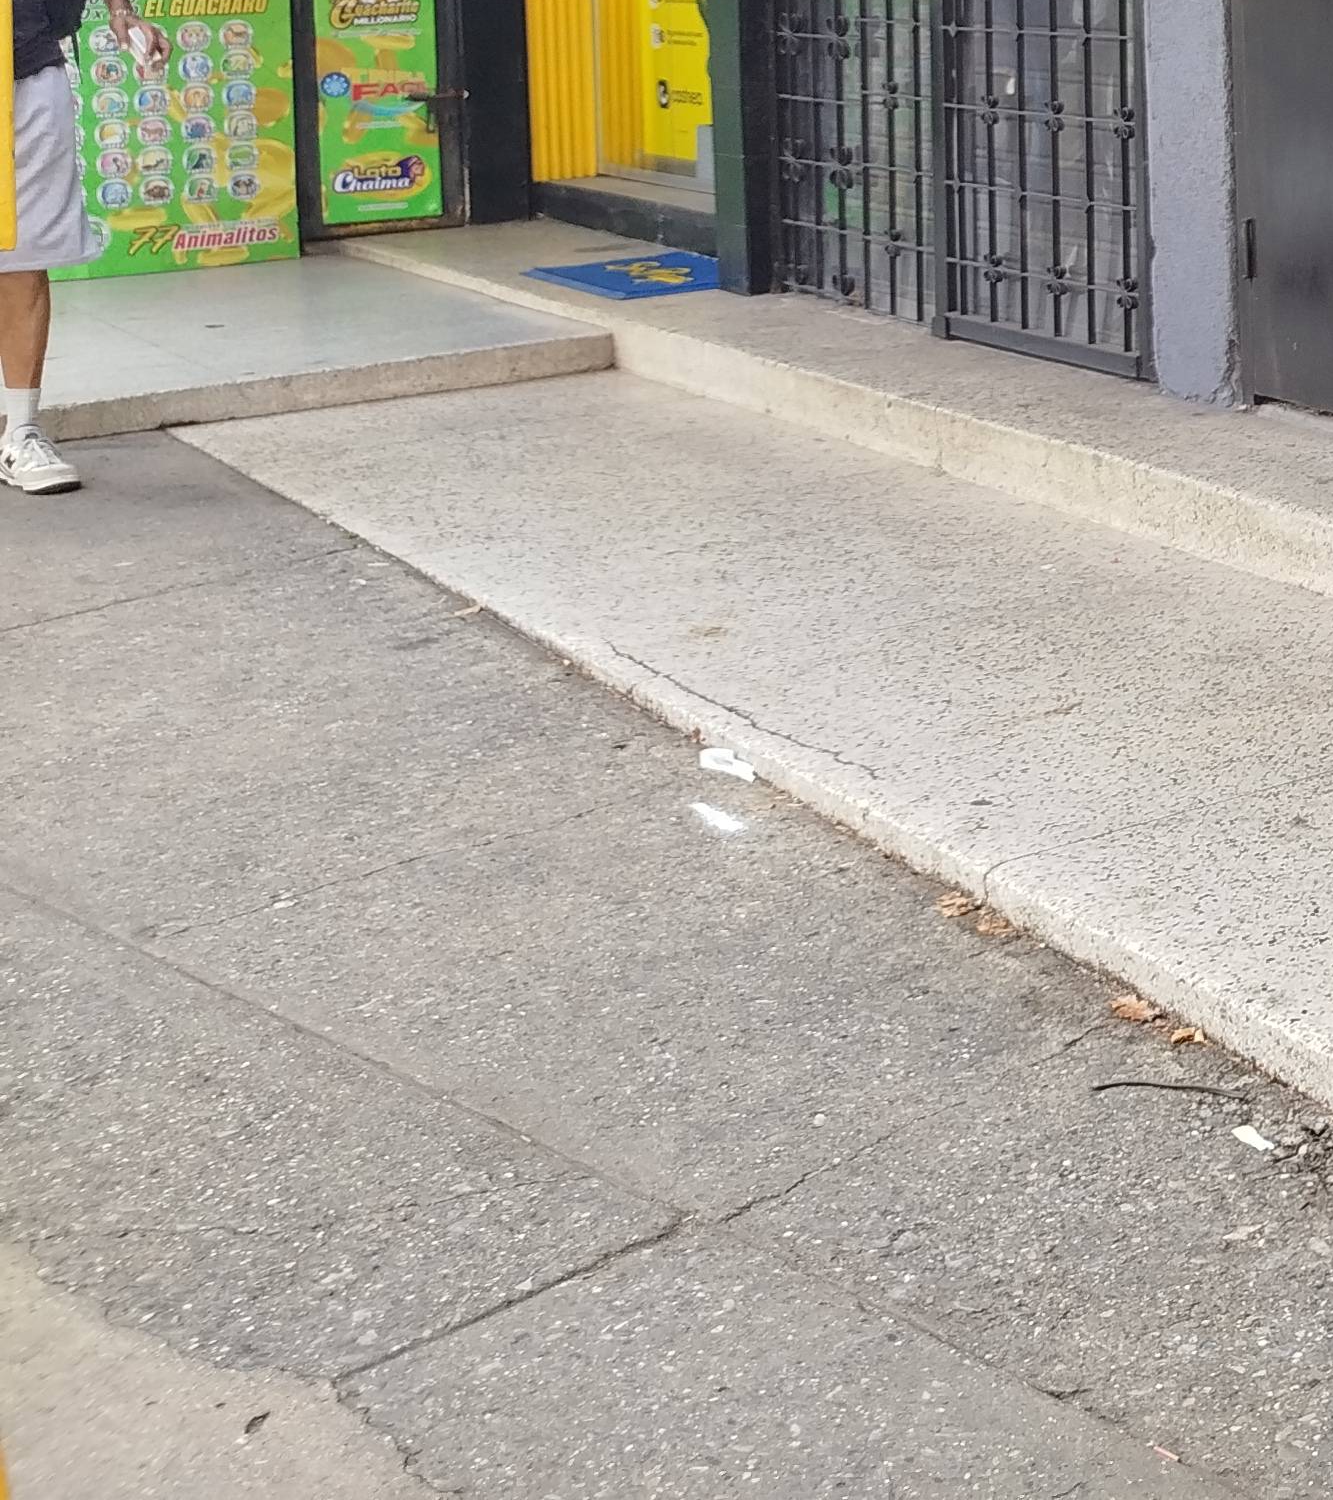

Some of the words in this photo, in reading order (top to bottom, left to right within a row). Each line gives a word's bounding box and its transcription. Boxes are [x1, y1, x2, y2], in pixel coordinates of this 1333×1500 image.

[144, 0, 165, 17] EL
[352, 165, 402, 178] Loto
[334, 171, 411, 193] Chaima
[128, 225, 181, 257] 77
[174, 227, 279, 250] Animalitos
